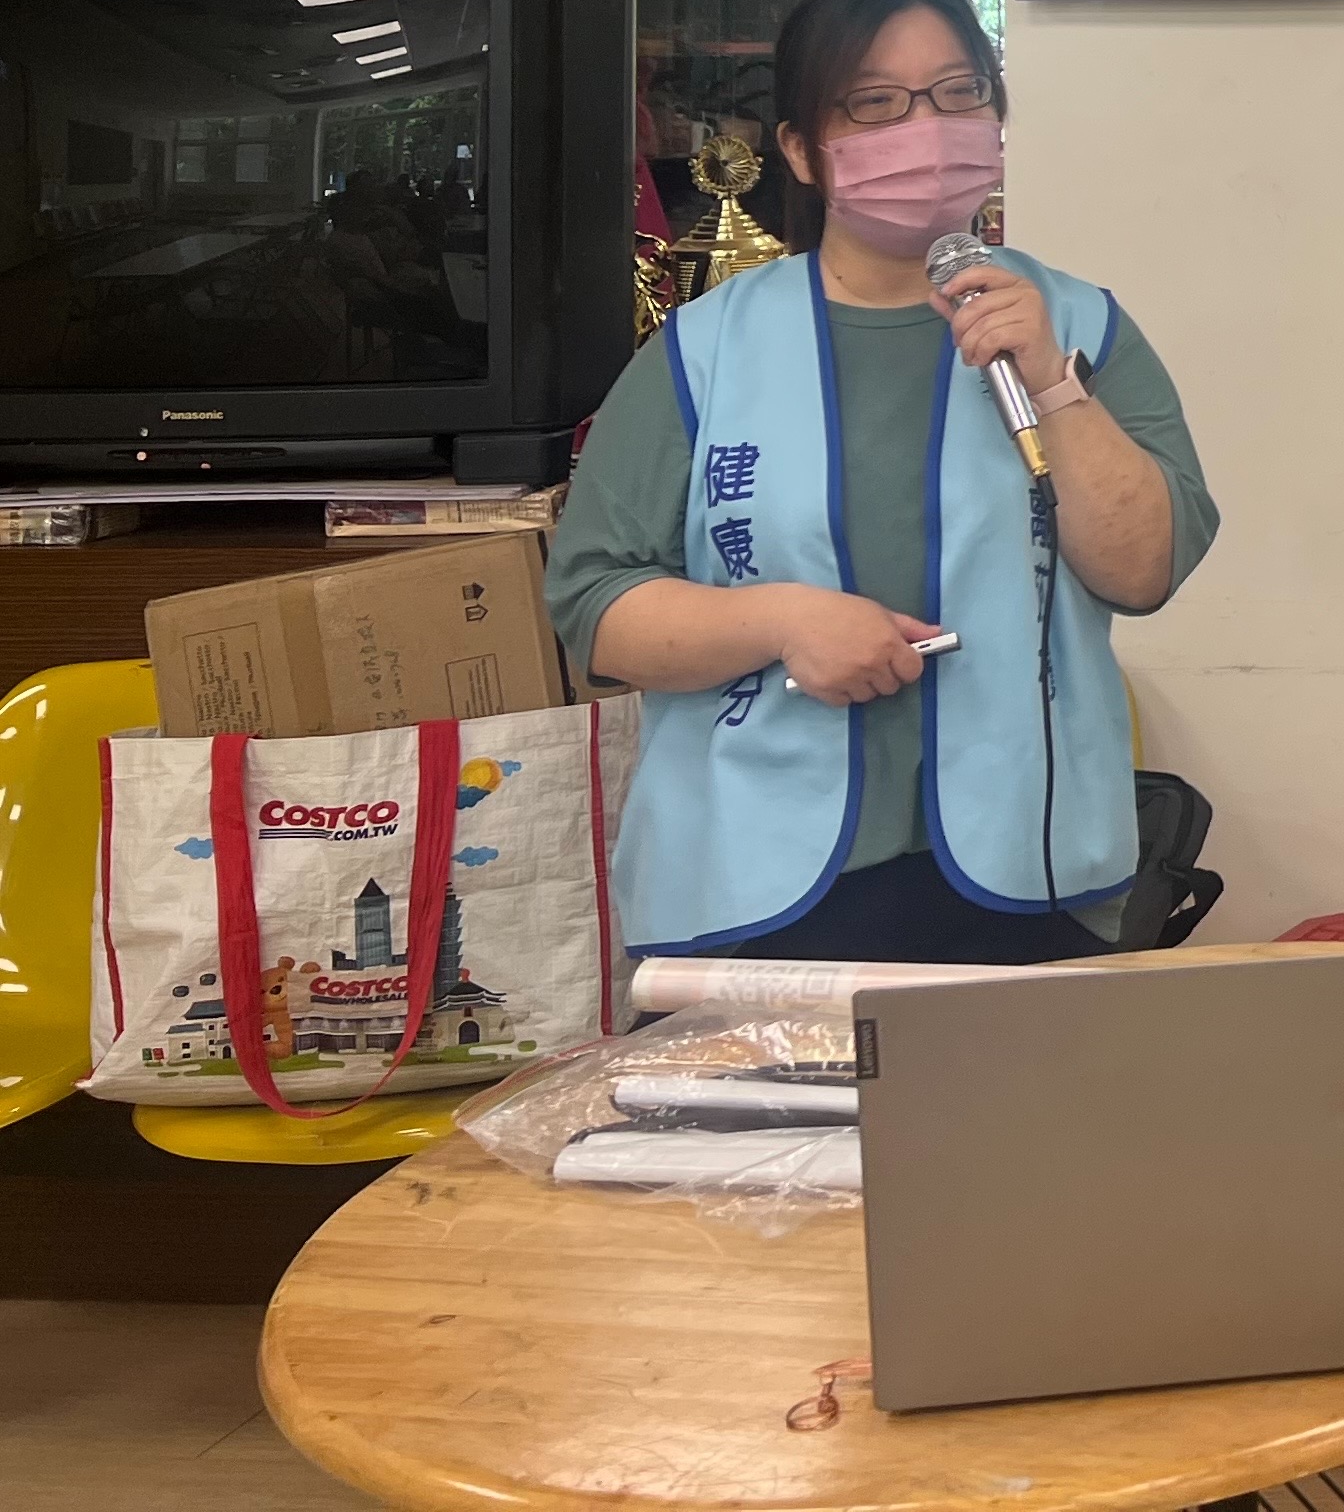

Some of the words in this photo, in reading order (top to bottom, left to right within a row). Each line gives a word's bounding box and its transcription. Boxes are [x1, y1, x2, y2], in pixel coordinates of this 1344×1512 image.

[162, 409, 224, 421] Panasonic
[704, 441, 762, 728] 健康分
[259, 800, 400, 829] COSTCO
